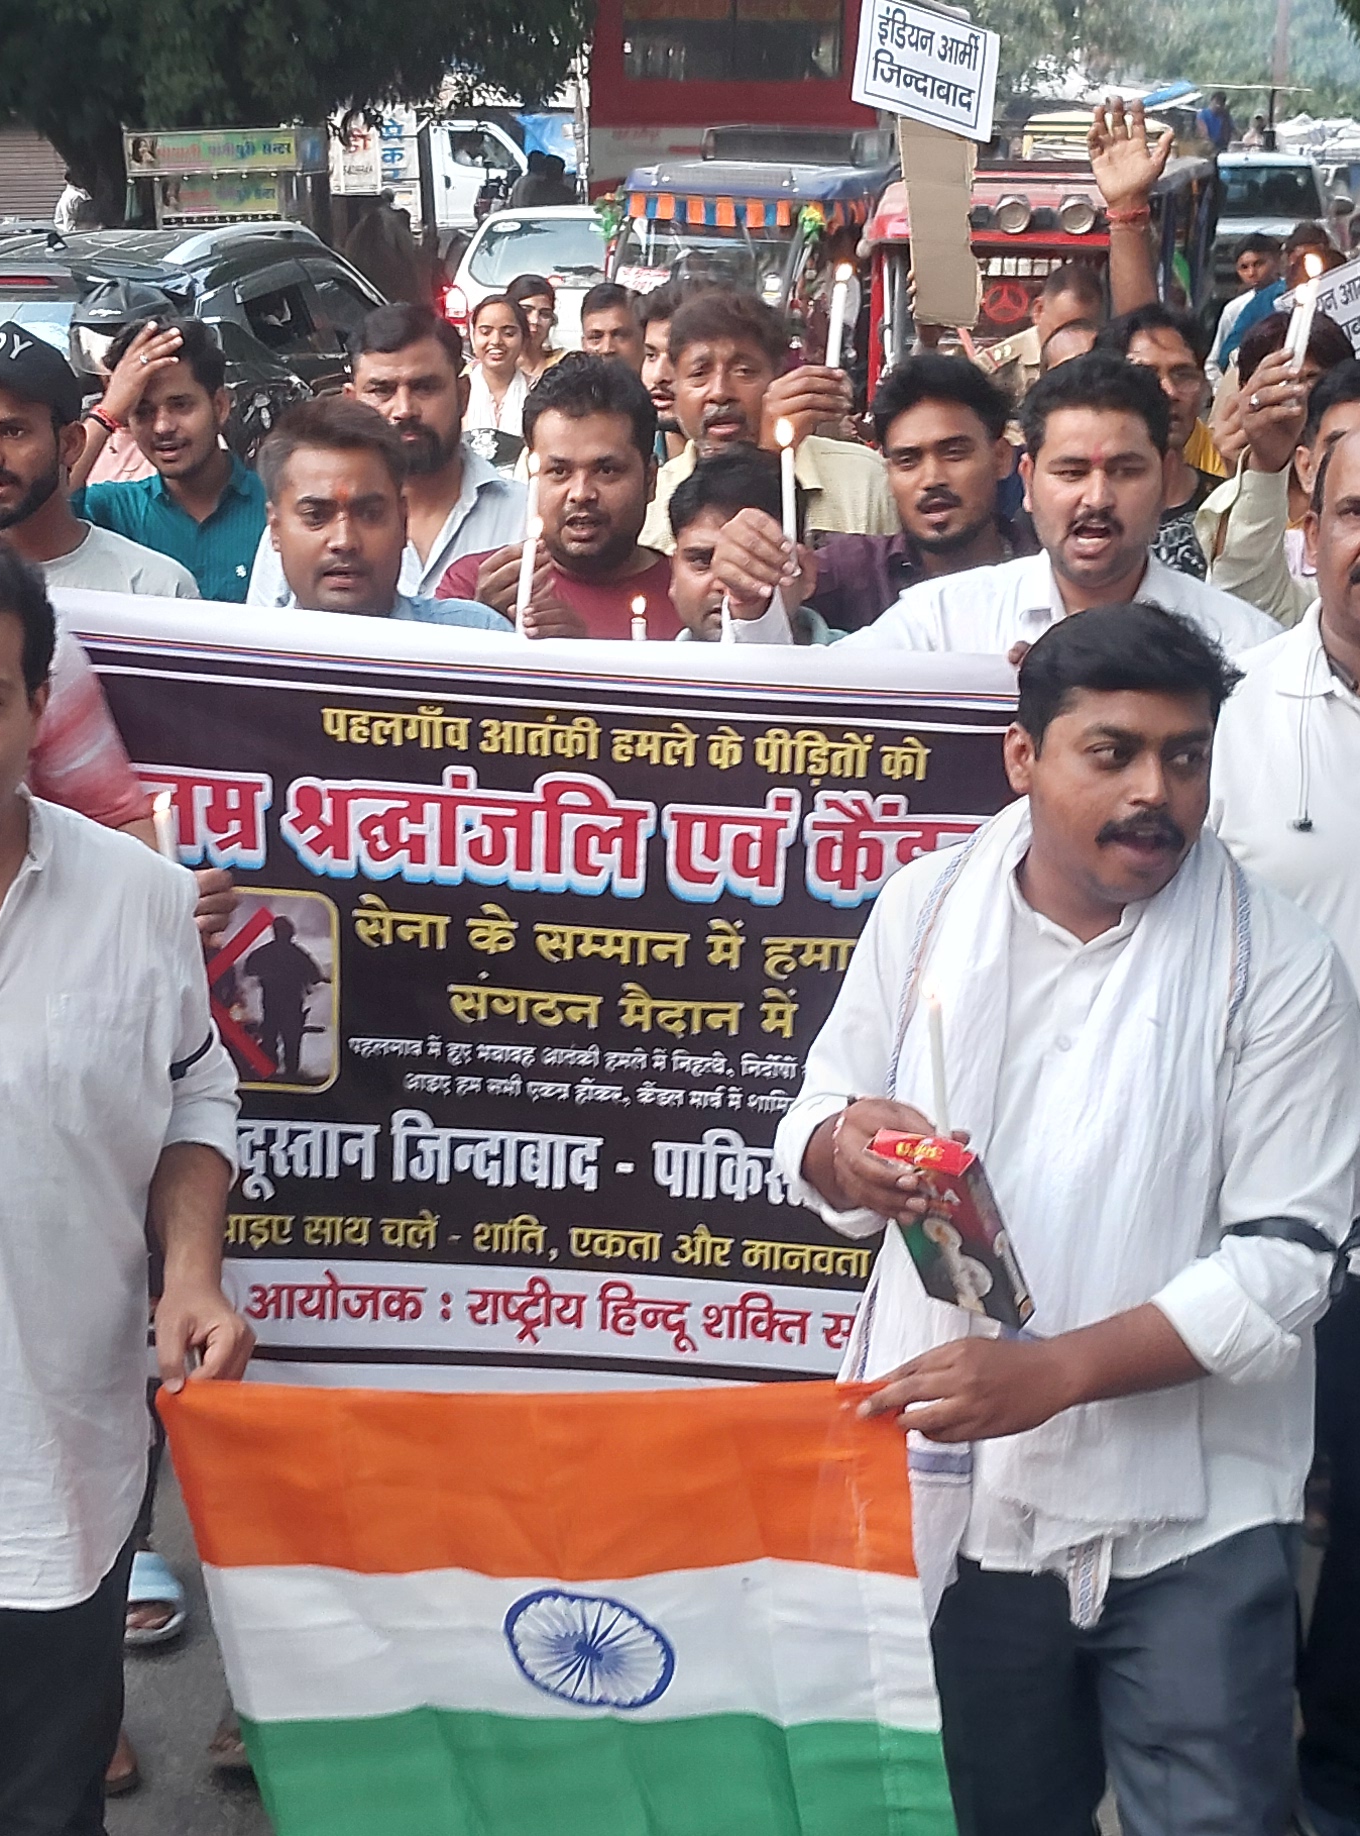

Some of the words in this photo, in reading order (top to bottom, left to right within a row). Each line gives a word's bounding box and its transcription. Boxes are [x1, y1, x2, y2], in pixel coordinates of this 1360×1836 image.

[877, 6, 935, 57] इंडियन
[938, 32, 980, 71] आर्मी
[872, 48, 975, 112] जिन्दाबाद
[479, 714, 602, 760] आतंकी
[611, 722, 700, 767] हमले
[707, 725, 745, 769] के
[753, 727, 875, 786] पीड़ितों
[881, 736, 932, 781] को
[137, 767, 269, 862] नम्र
[285, 768, 653, 889] श्रद्धांजलि
[665, 792, 797, 897] एवं
[806, 794, 988, 899] कैंड
[352, 893, 452, 952] सेना
[466, 902, 519, 956] के
[534, 921, 690, 969] सम्मान
[706, 918, 746, 972] में
[762, 936, 858, 981] हमा
[447, 971, 604, 1031] संगठन
[619, 982, 744, 1039] मैदान
[760, 987, 800, 1040] में
[746, 1088, 796, 1113] शामि
[237, 1118, 381, 1201] दूस्तान
[390, 1109, 604, 1191] जिन्दाबाद
[616, 1161, 634, 1175] -
[302, 1213, 373, 1247] साथ
[568, 1225, 663, 1263] एकता
[672, 1222, 735, 1267] और
[741, 1238, 873, 1279] मानवता
[244, 1268, 428, 1322] आयोजक
[467, 1274, 588, 1345] राष्ट्रीय
[597, 1279, 699, 1353] हिन्दू
[702, 1290, 813, 1346] शक्ति
